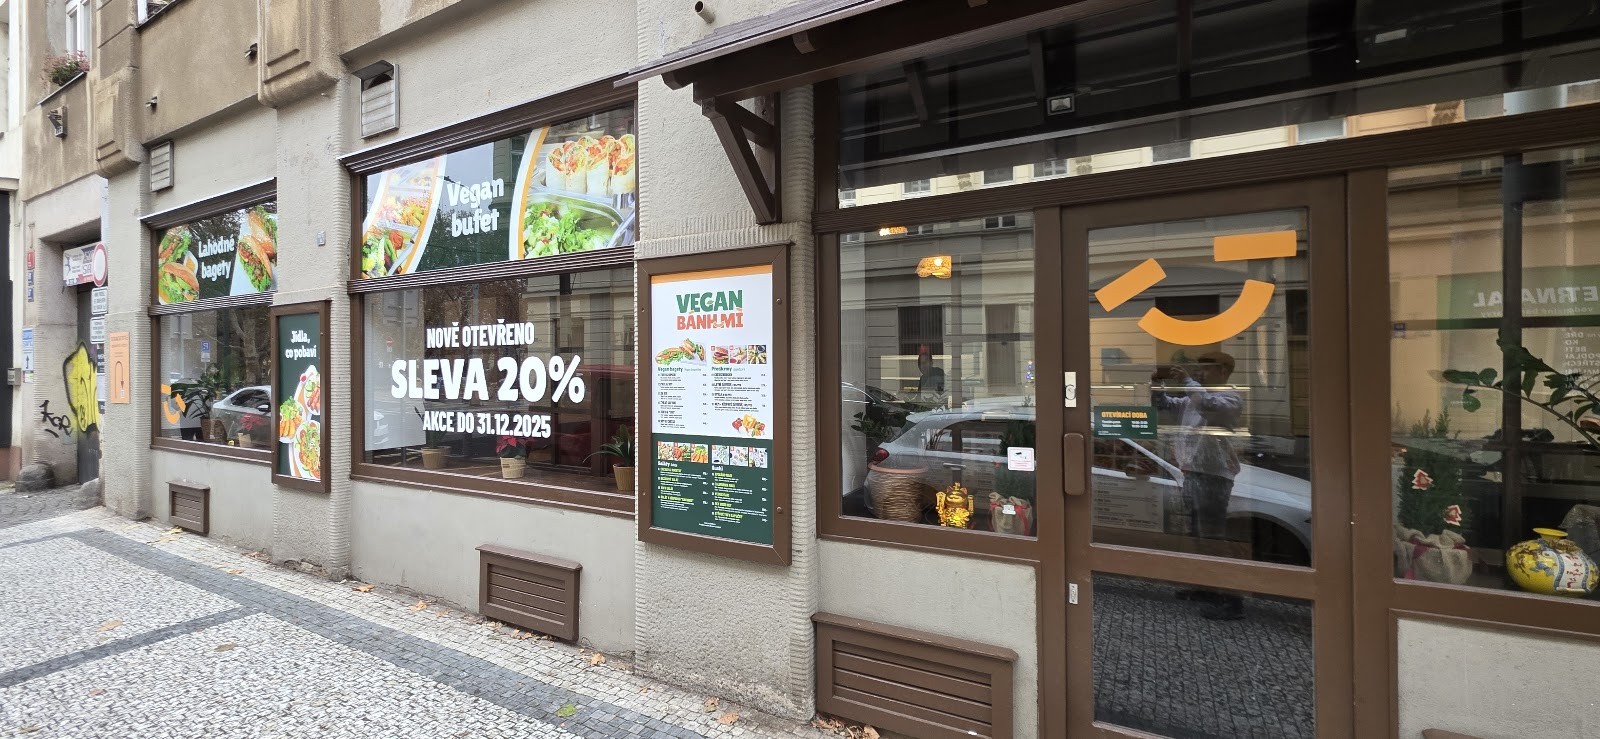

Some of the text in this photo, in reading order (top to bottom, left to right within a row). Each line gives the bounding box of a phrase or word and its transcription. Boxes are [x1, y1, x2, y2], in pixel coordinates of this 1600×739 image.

[446, 178, 504, 208] Vegan
[451, 208, 499, 237] bufet
[198, 235, 235, 258] Lahodné
[201, 260, 232, 281] bagety
[676, 289, 743, 314] VEGAN
[290, 330, 310, 344] Jídla,
[426, 318, 535, 349] NOVĚ OTEVŘENO
[285, 345, 317, 360] co pobaví
[391, 354, 586, 404] SLEVA 20%
[422, 410, 552, 439] AKCE DO 31.12.2025
